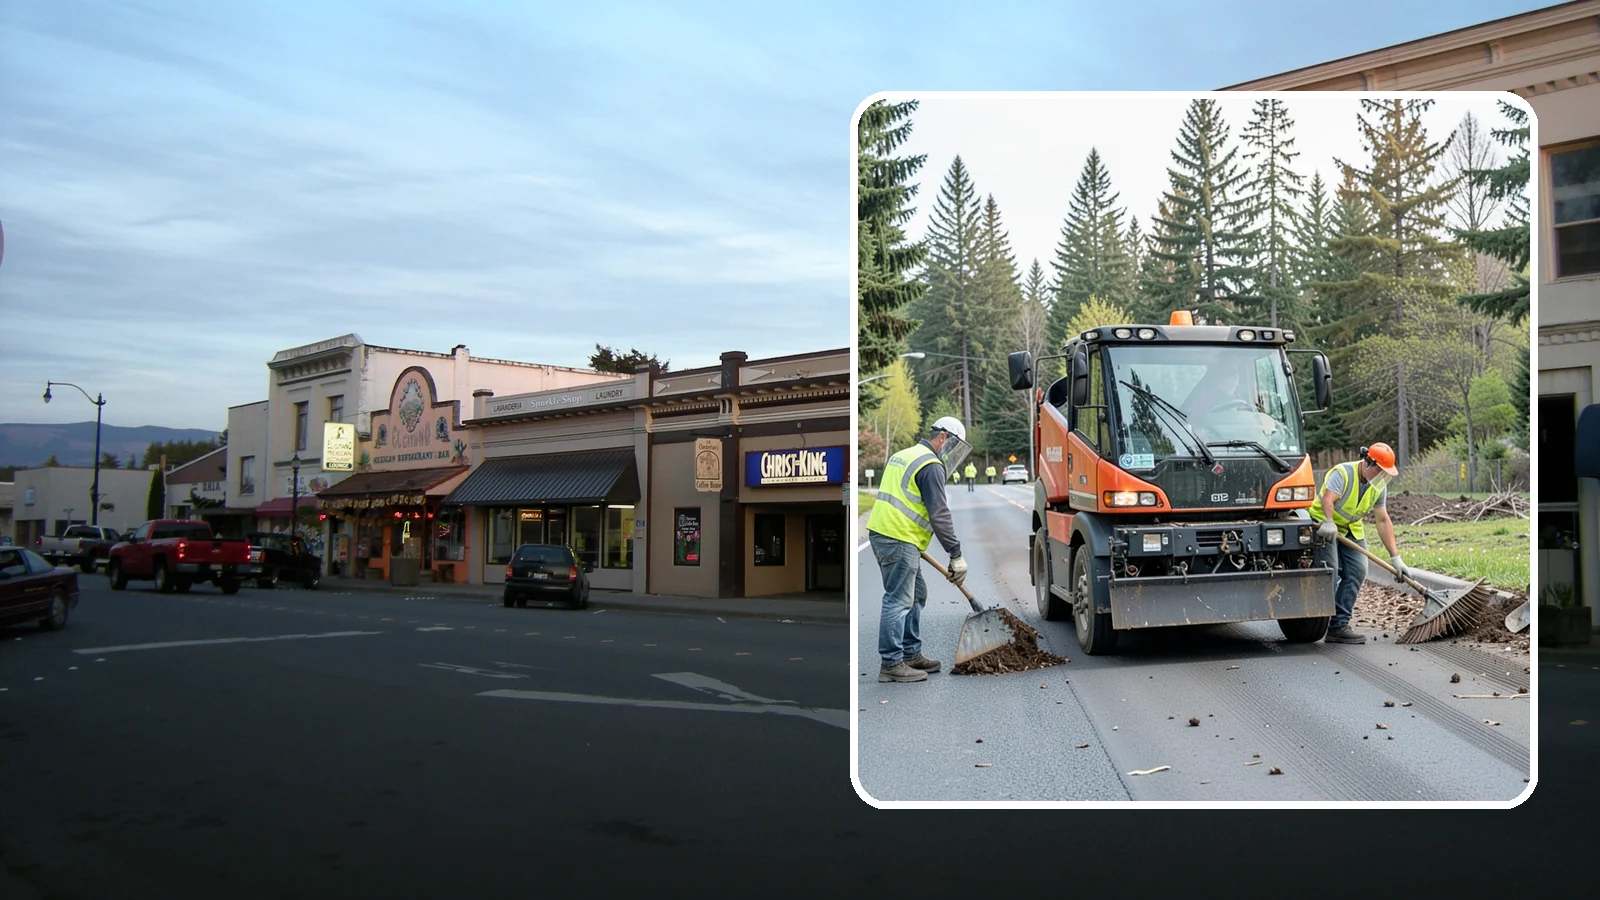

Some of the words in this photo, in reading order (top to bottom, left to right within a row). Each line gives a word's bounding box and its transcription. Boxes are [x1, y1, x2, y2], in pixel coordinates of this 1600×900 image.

[595, 389, 624, 400] LAUNDRY
[494, 402, 522, 412] LAVANDERIA
[531, 396, 560, 409] Sparkle
[562, 394, 582, 406] Shop
[398, 451, 433, 461] RESTAURANT
[438, 450, 450, 459] BAR
[761, 452, 797, 478] CHRIST
[799, 450, 827, 476] KING
[696, 480, 709, 489] Coffee
